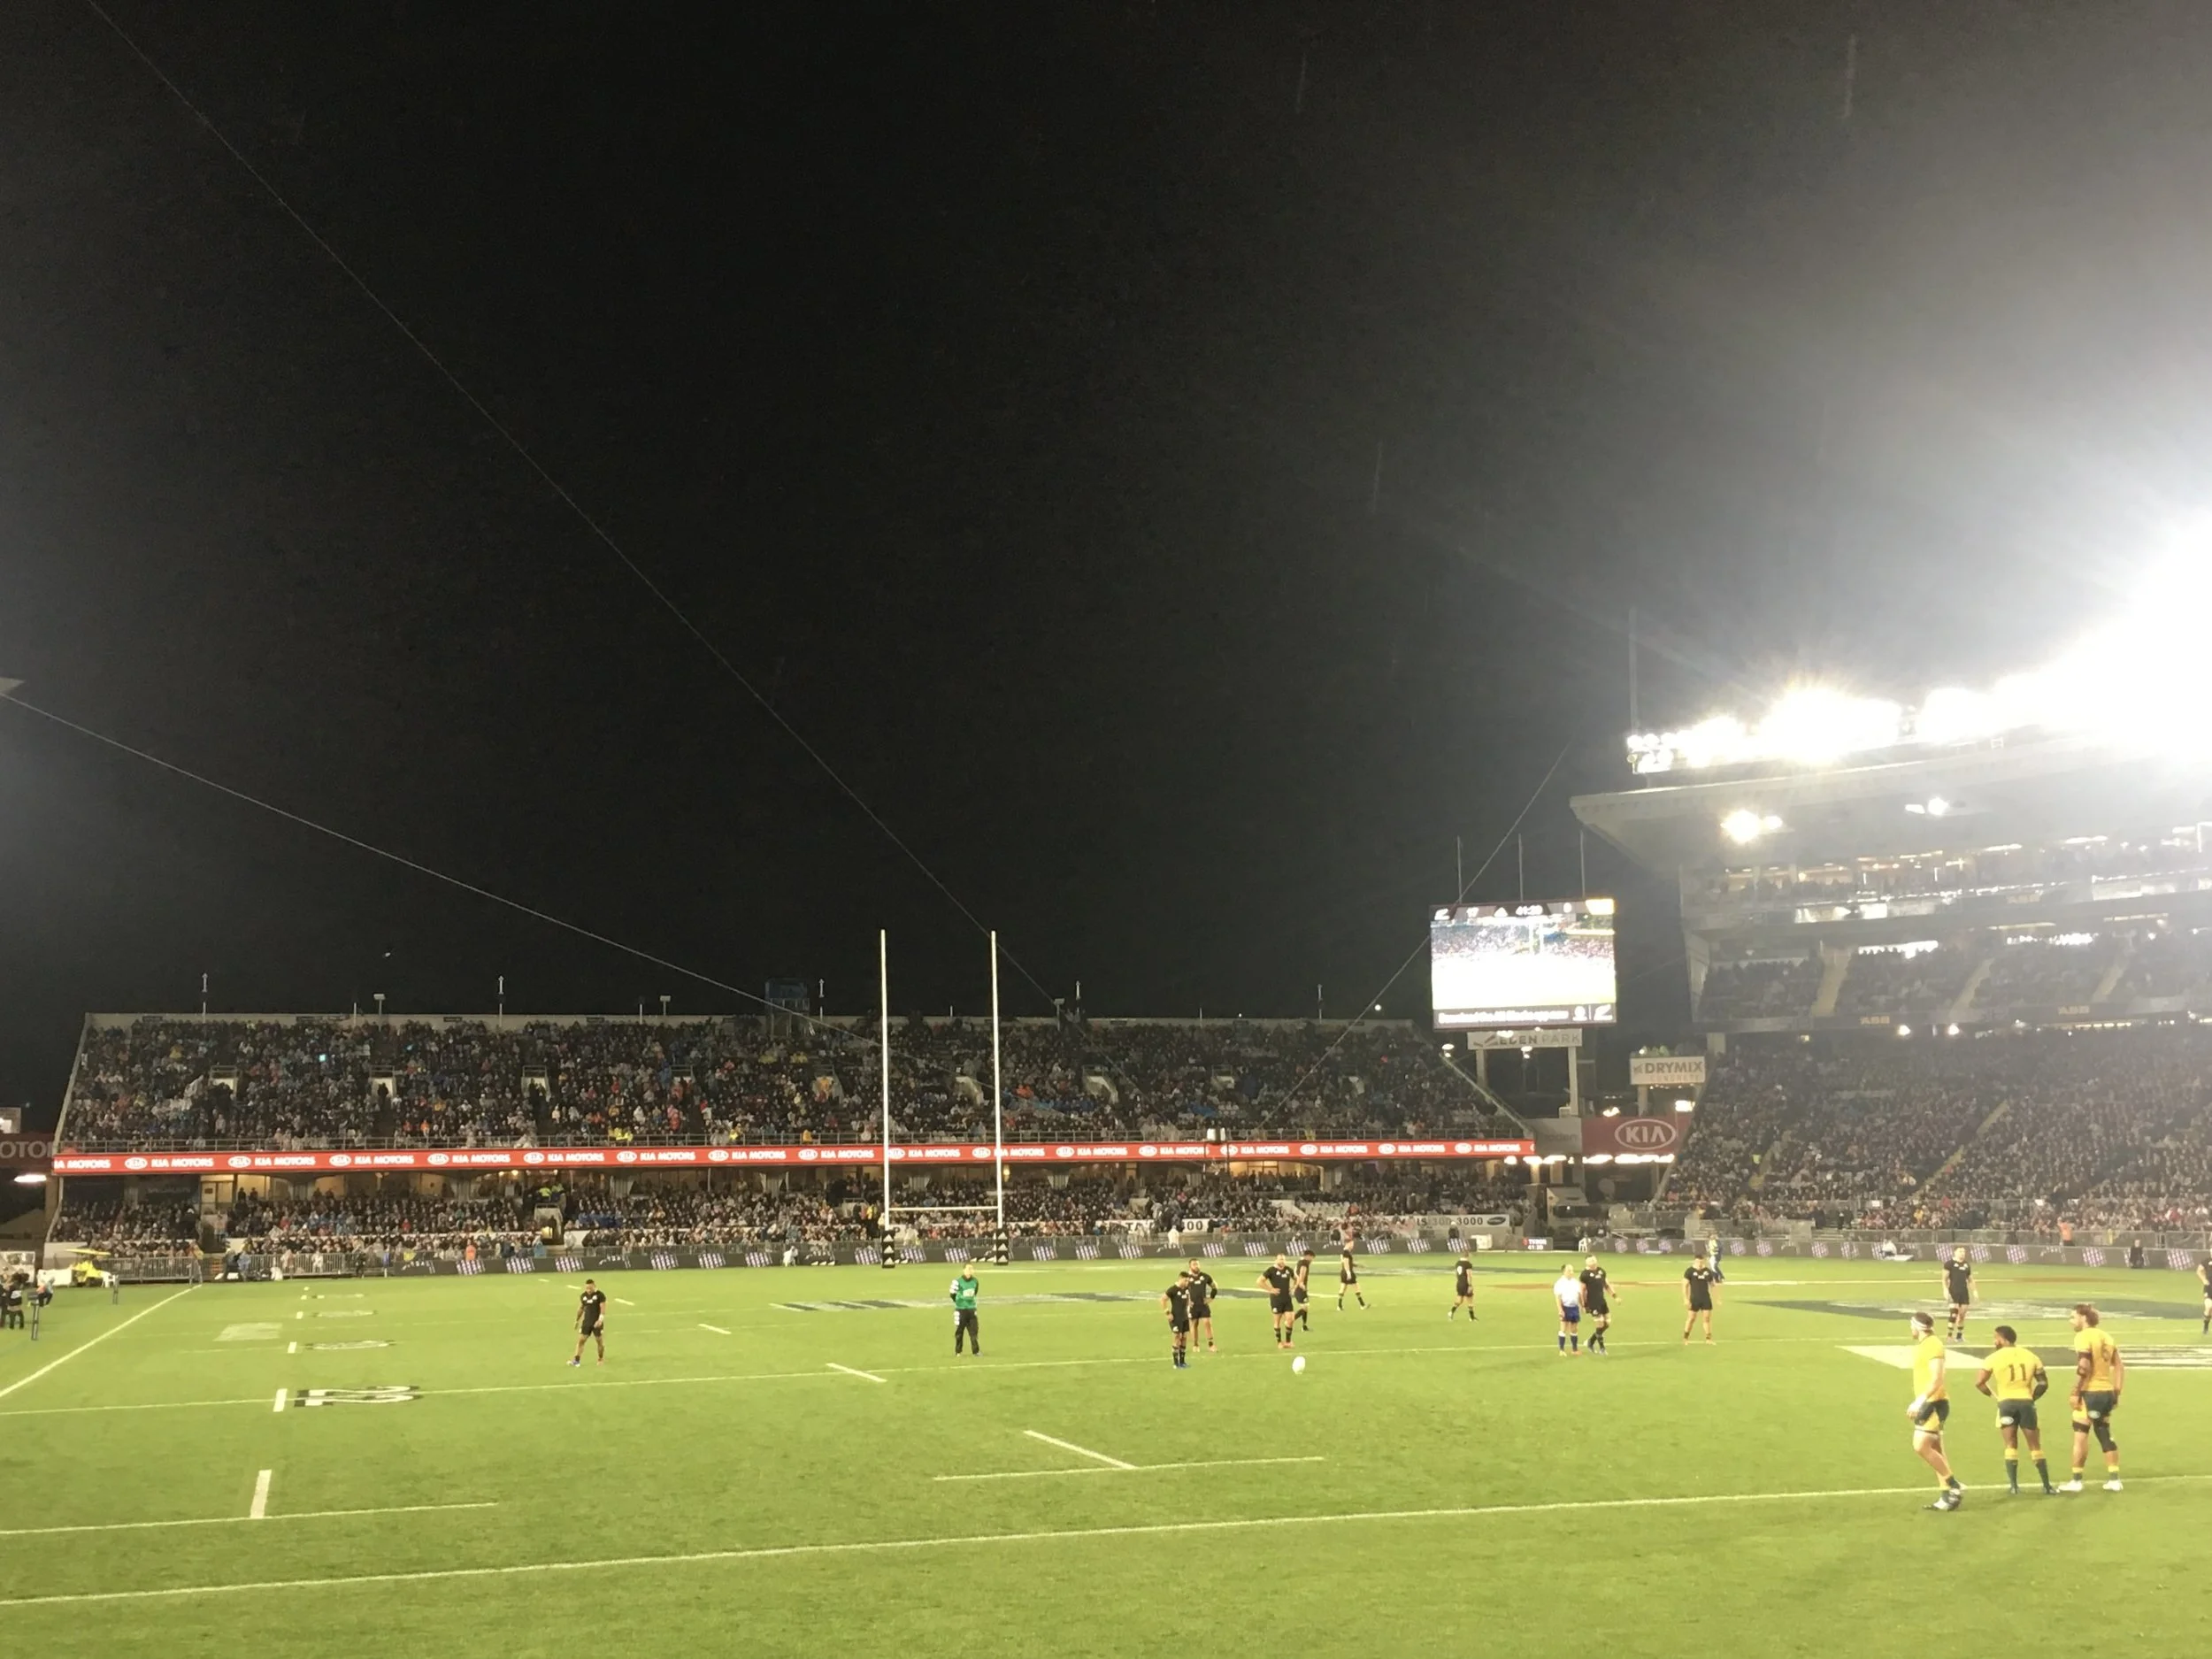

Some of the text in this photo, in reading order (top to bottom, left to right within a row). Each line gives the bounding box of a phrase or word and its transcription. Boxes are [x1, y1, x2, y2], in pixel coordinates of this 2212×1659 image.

[1541, 1033, 1580, 1044] PARK
[1645, 1062, 1703, 1074] DRYMIX
[1625, 1126, 1666, 1143] KIA
[732, 1151, 748, 1160] KIA
[749, 1150, 787, 1160] MOTORS
[821, 1150, 836, 1159] KIA
[838, 1149, 875, 1159] MOTORS
[908, 1149, 924, 1158] KIA
[925, 1148, 961, 1158] MOTORS
[1010, 1148, 1045, 1157] MOTORS
[1077, 1148, 1092, 1156] KIA
[1093, 1147, 1128, 1156] MOTORS
[255, 1156, 272, 1167] KIA
[273, 1156, 317, 1166] MOTORS
[355, 1156, 372, 1164] KIA
[373, 1155, 414, 1164] MOTORS
[452, 1154, 469, 1164] KIA
[471, 1154, 511, 1164] MOTORS
[548, 1153, 564, 1163] KIA
[565, 1153, 604, 1163] MOTORS
[640, 1152, 657, 1162] KIA
[657, 1152, 696, 1161] MOTORS
[67, 1159, 111, 1170] MOTORS
[151, 1158, 170, 1168] KIA
[171, 1157, 214, 1168] MOTORS
[1457, 1217, 1484, 1226] 3000
[2008, 1363, 2026, 1382] 11
